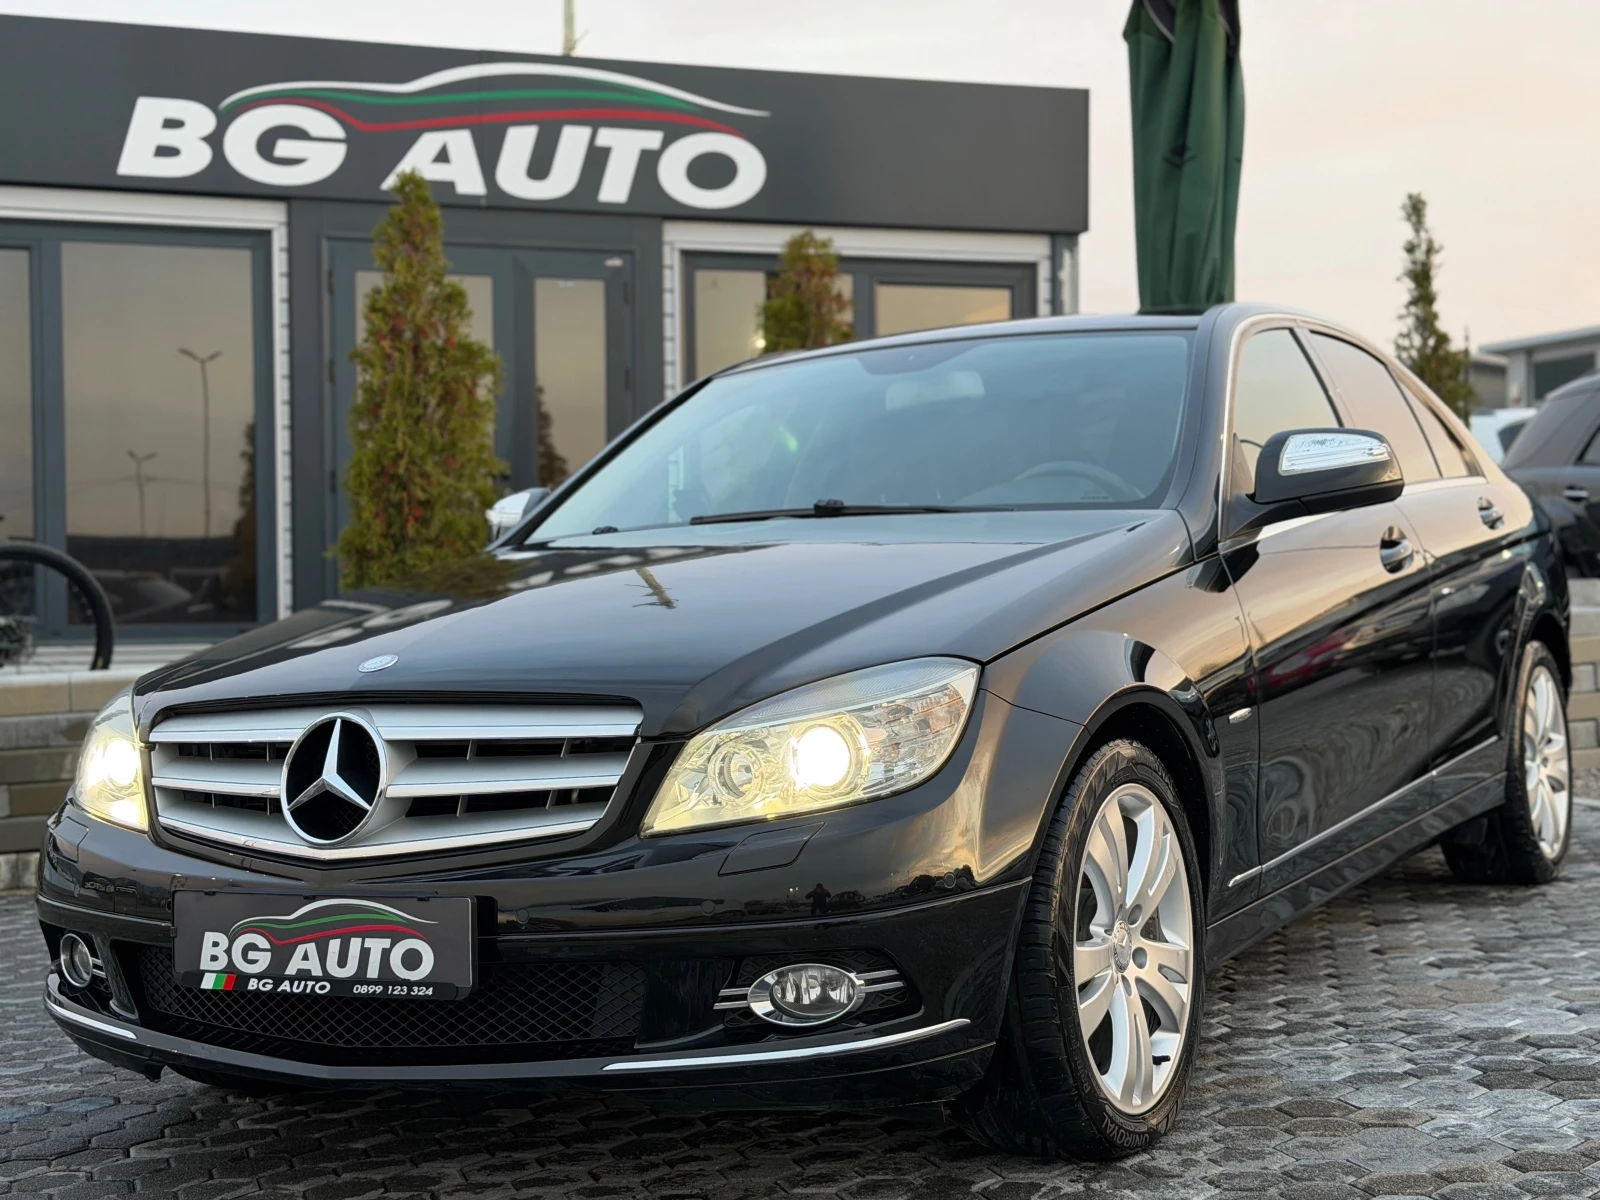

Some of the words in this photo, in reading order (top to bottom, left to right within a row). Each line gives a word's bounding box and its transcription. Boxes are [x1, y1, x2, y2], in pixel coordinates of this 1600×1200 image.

[116, 96, 348, 187] BG
[380, 125, 767, 210] AUTO
[199, 931, 272, 974] BG
[283, 937, 435, 982] AUTO
[247, 978, 274, 992] BG
[276, 980, 331, 995] AUTO
[352, 984, 384, 995] 0899
[387, 985, 408, 996] 123
[410, 986, 434, 997] 324
[1101, 1111, 1150, 1149] UNIROYAL
